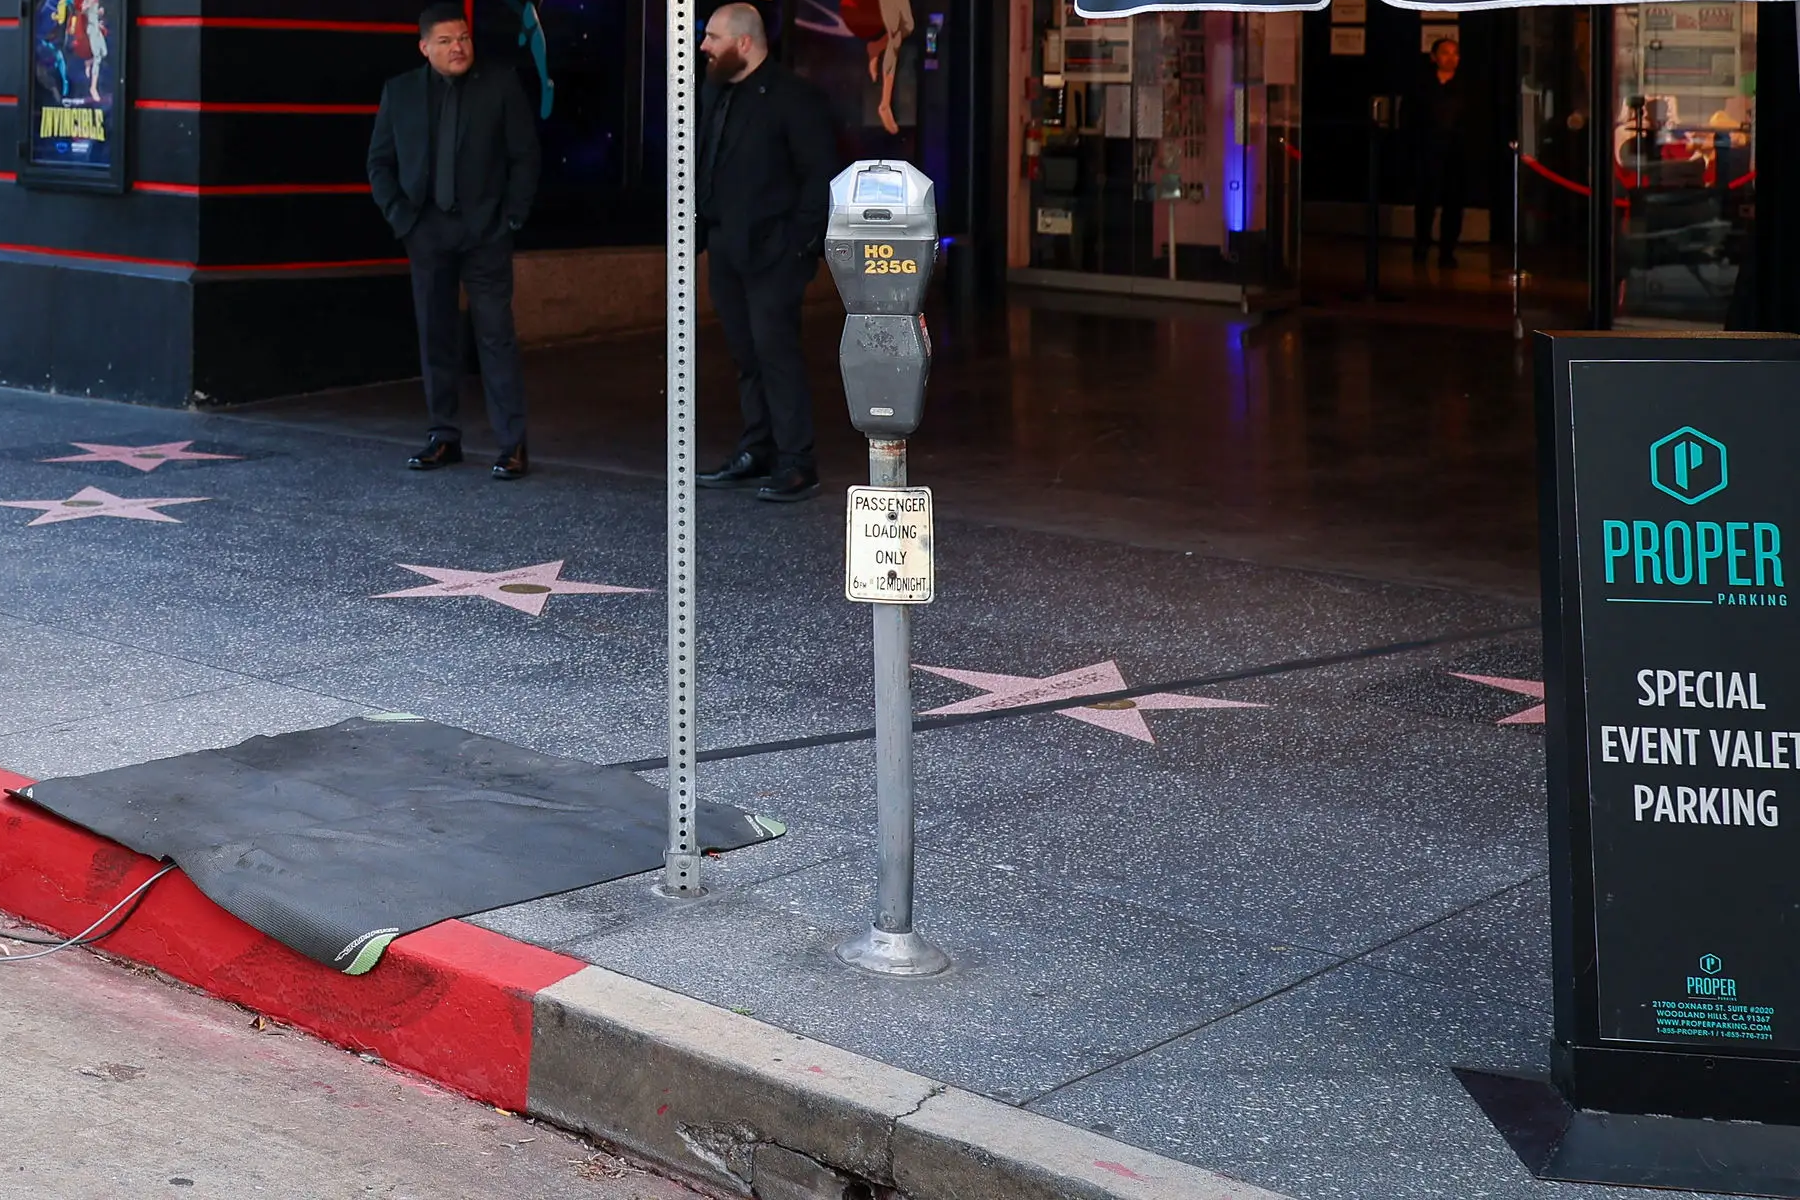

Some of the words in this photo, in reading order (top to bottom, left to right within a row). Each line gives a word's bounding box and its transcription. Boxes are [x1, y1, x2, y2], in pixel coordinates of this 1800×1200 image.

[40, 106, 105, 142] INVINCIBLE
[864, 244, 894, 259] HO
[864, 259, 917, 274] 235G
[855, 496, 926, 512] PASSENGER
[865, 523, 917, 539] LOADING
[875, 550, 907, 565] ONLY
[1603, 519, 1785, 588] PROPER
[853, 576, 860, 589] 6
[876, 576, 886, 591] 12
[887, 577, 927, 591] MIDNIGHT
[1717, 592, 1788, 607] PARKING
[1637, 667, 1767, 711] SPECIAL
[1601, 724, 1701, 767] EVENT
[1633, 783, 1780, 828] PARKING
[1686, 976, 1737, 997] PROPER
[1652, 1000, 1676, 1010] 21700
[1677, 1002, 1713, 1011] OXNARD
[1715, 1004, 1726, 1012] ST.
[1727, 1005, 1748, 1013] SUITE
[1749, 1006, 1775, 1015] #2020
[1656, 1009, 1706, 1019] WOODLAND
[1707, 1013, 1730, 1022] HILLS,
[1731, 1014, 1745, 1022] CA
[1746, 1015, 1771, 1023] 91367
[1656, 1018, 1772, 1032] WWW.PROPERPARKING.COM
